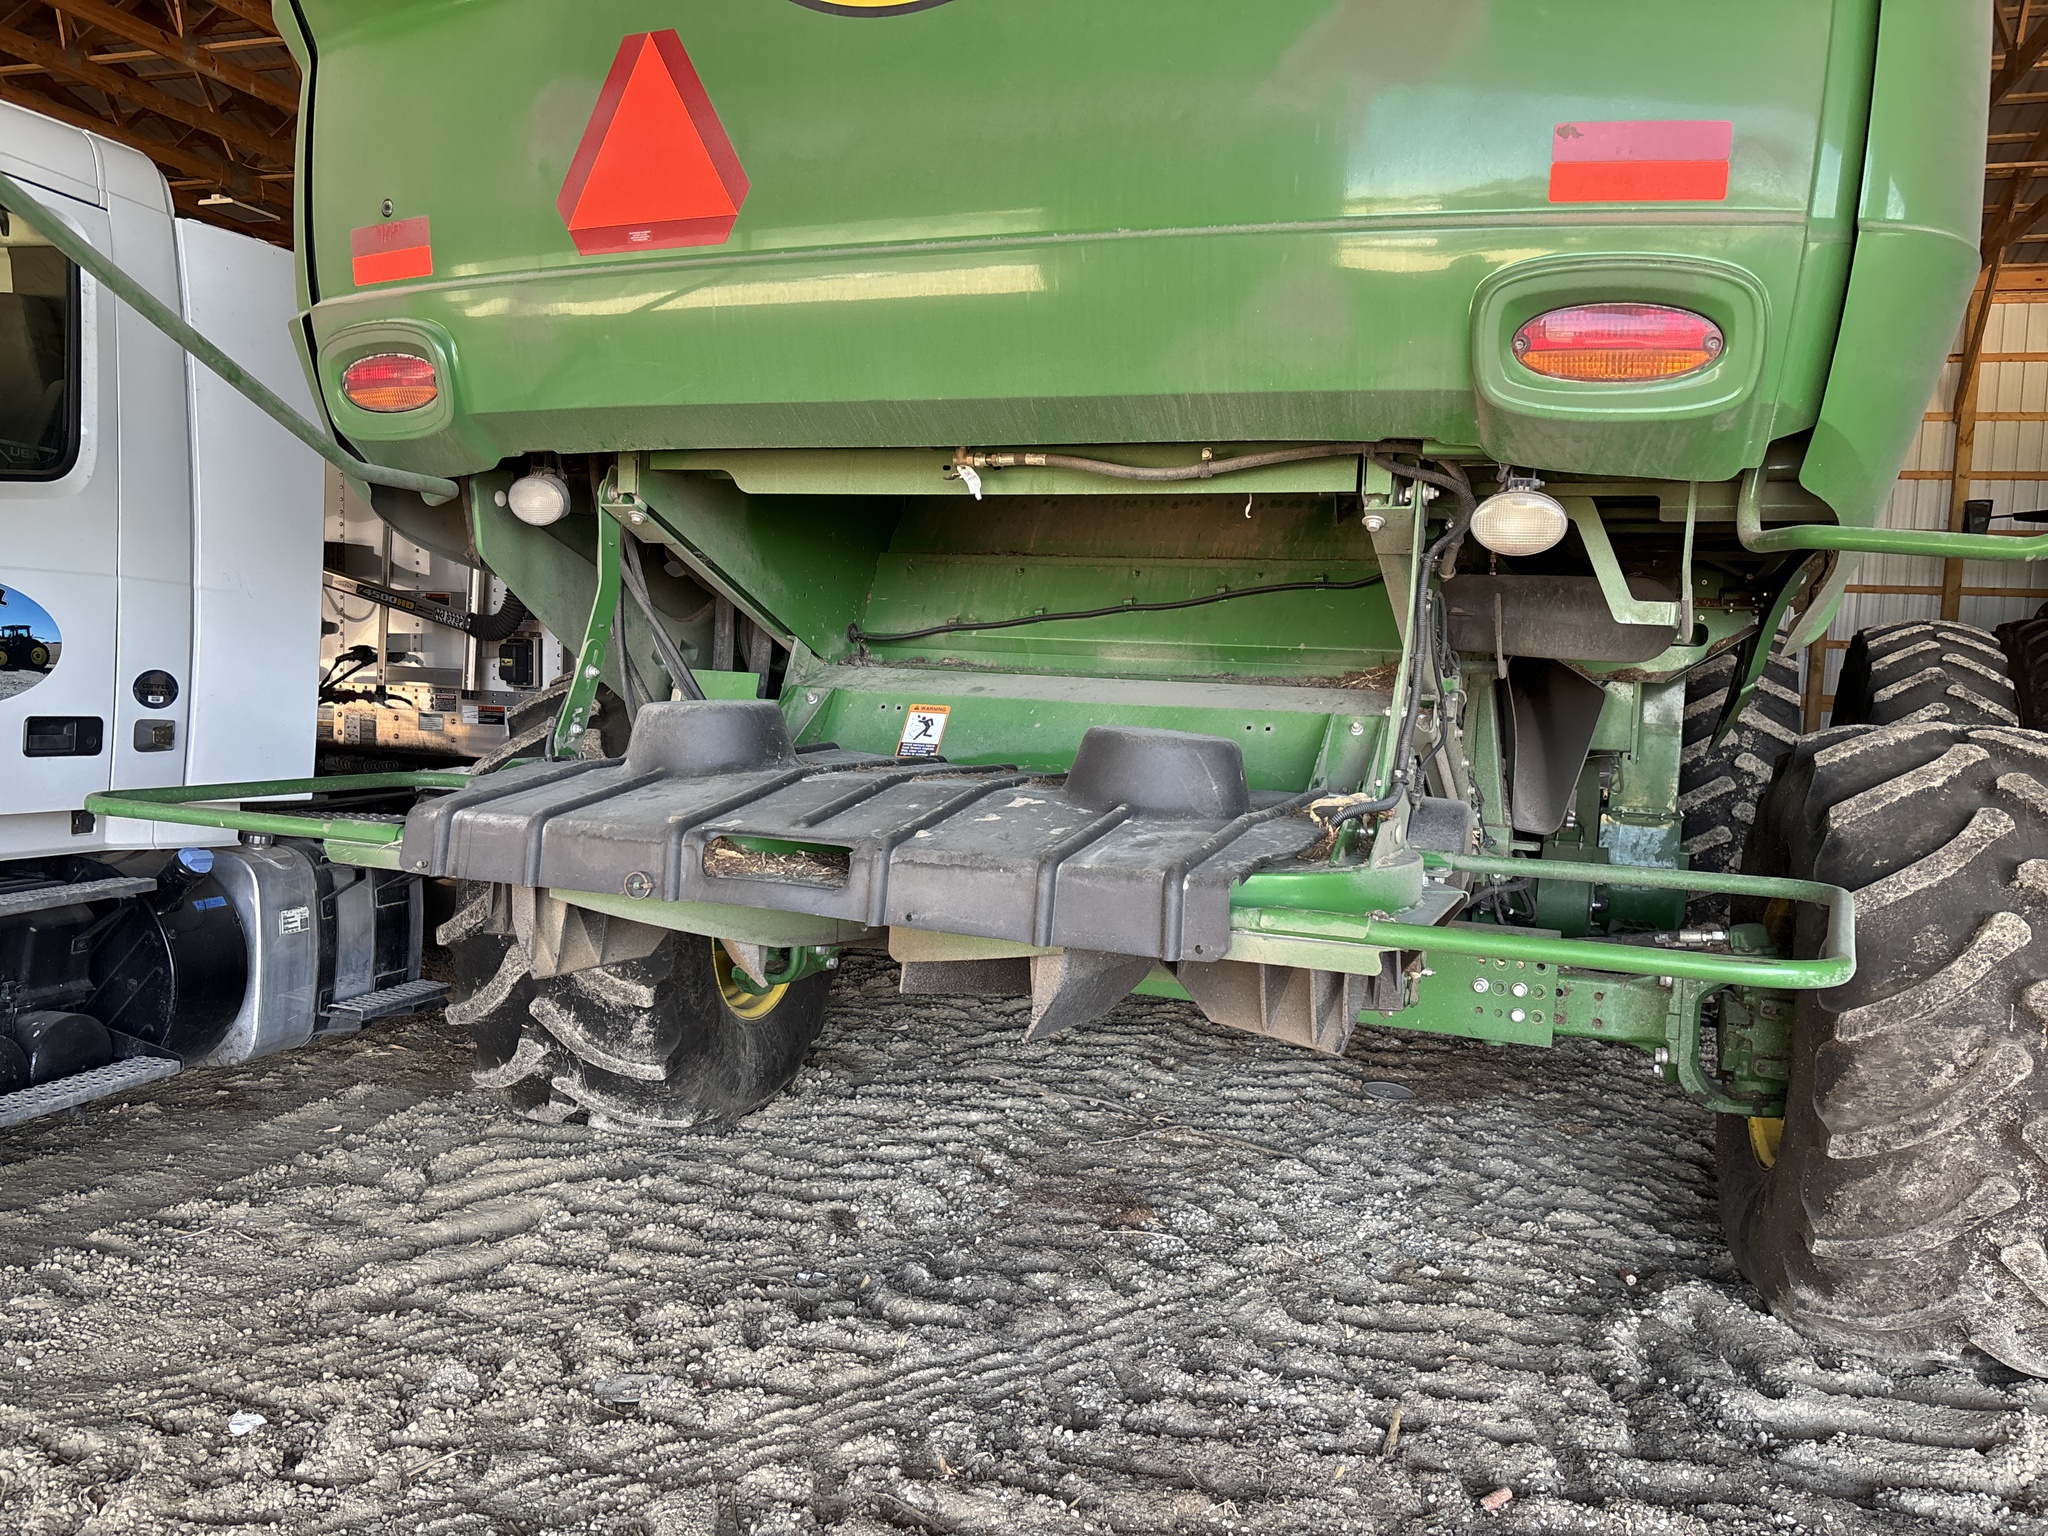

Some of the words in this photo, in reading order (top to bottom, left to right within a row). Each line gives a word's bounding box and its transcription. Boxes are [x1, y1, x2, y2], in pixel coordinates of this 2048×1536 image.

[10, 446, 41, 461] USA
[362, 588, 415, 610] 4500HD
[435, 610, 445, 619] NO
[446, 614, 463, 624] STEP
